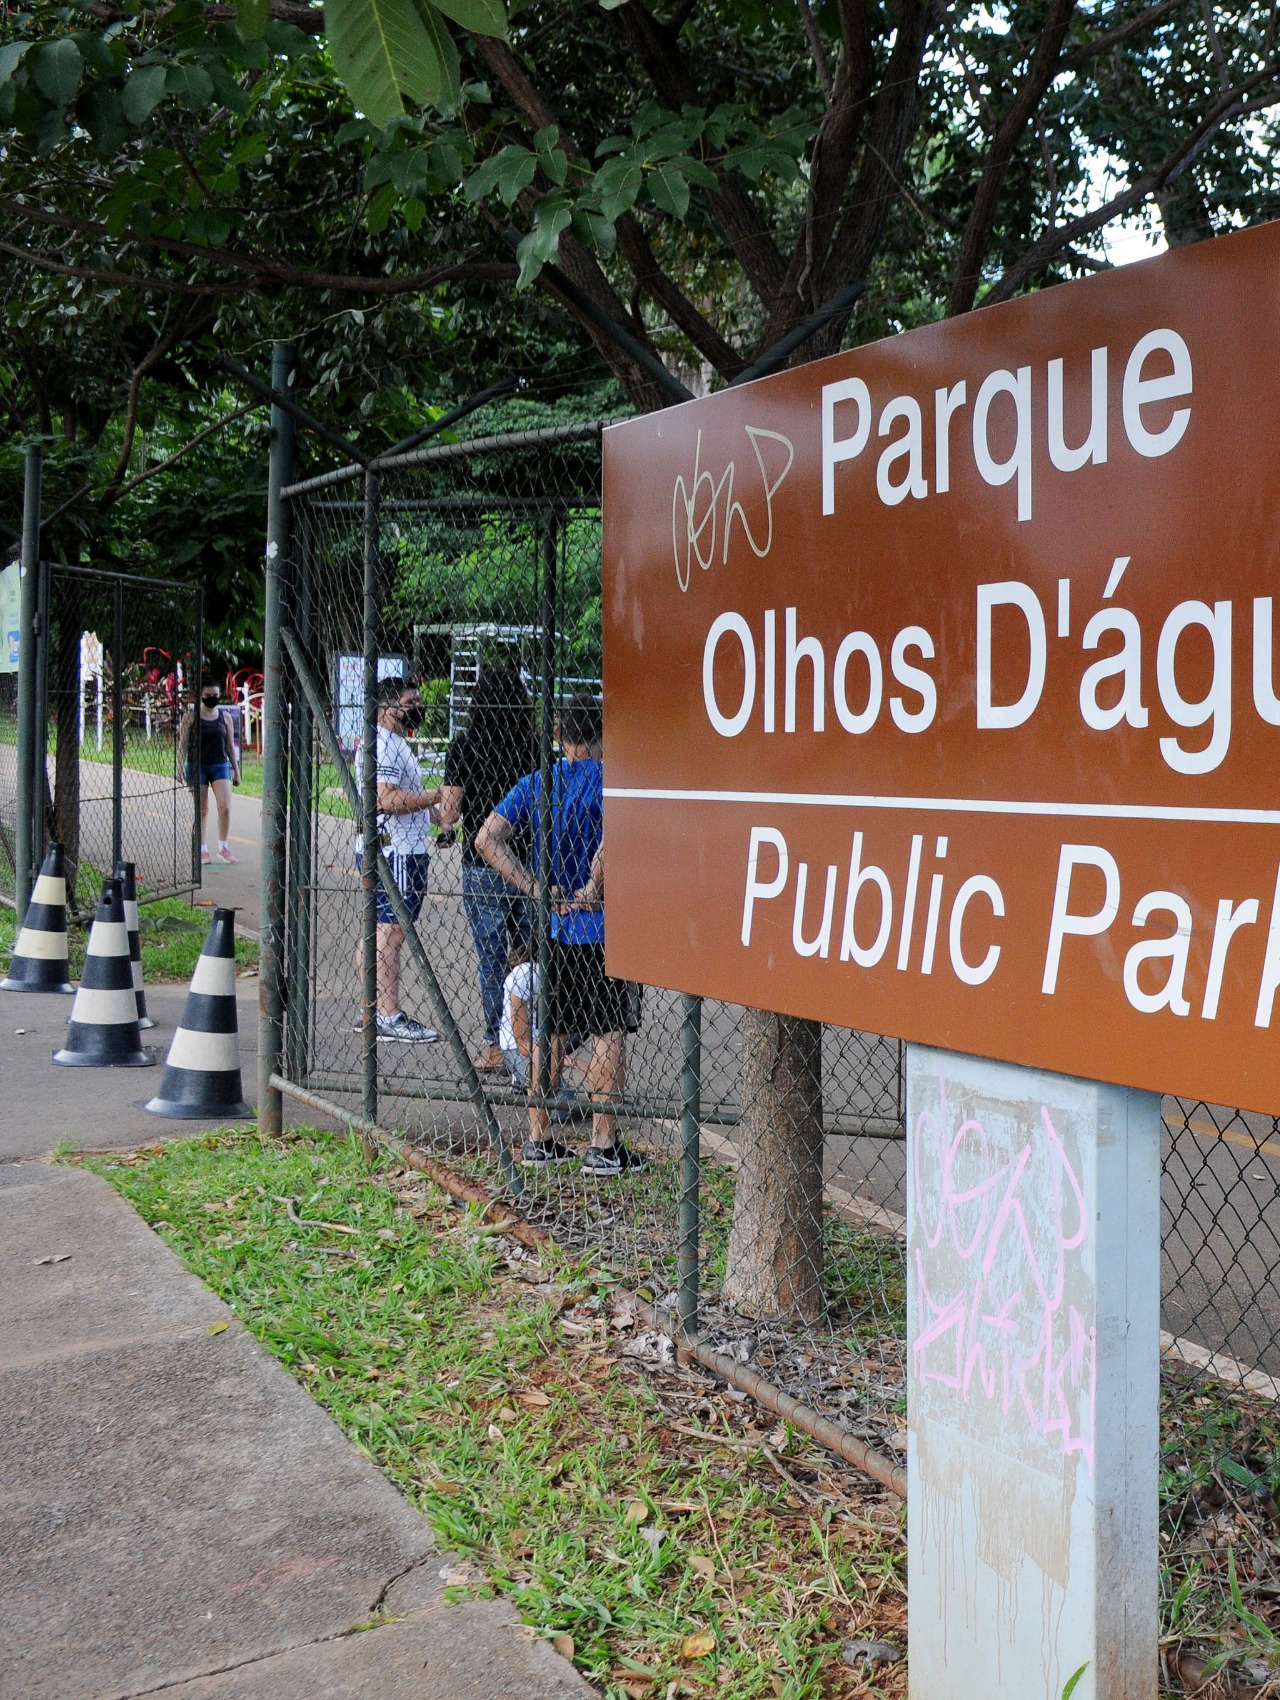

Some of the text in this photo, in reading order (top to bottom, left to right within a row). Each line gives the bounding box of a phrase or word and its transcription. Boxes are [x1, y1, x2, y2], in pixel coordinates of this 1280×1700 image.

[821, 328, 1193, 522] Parque
[702, 606, 938, 738] Olhos
[740, 826, 1005, 987] Public
